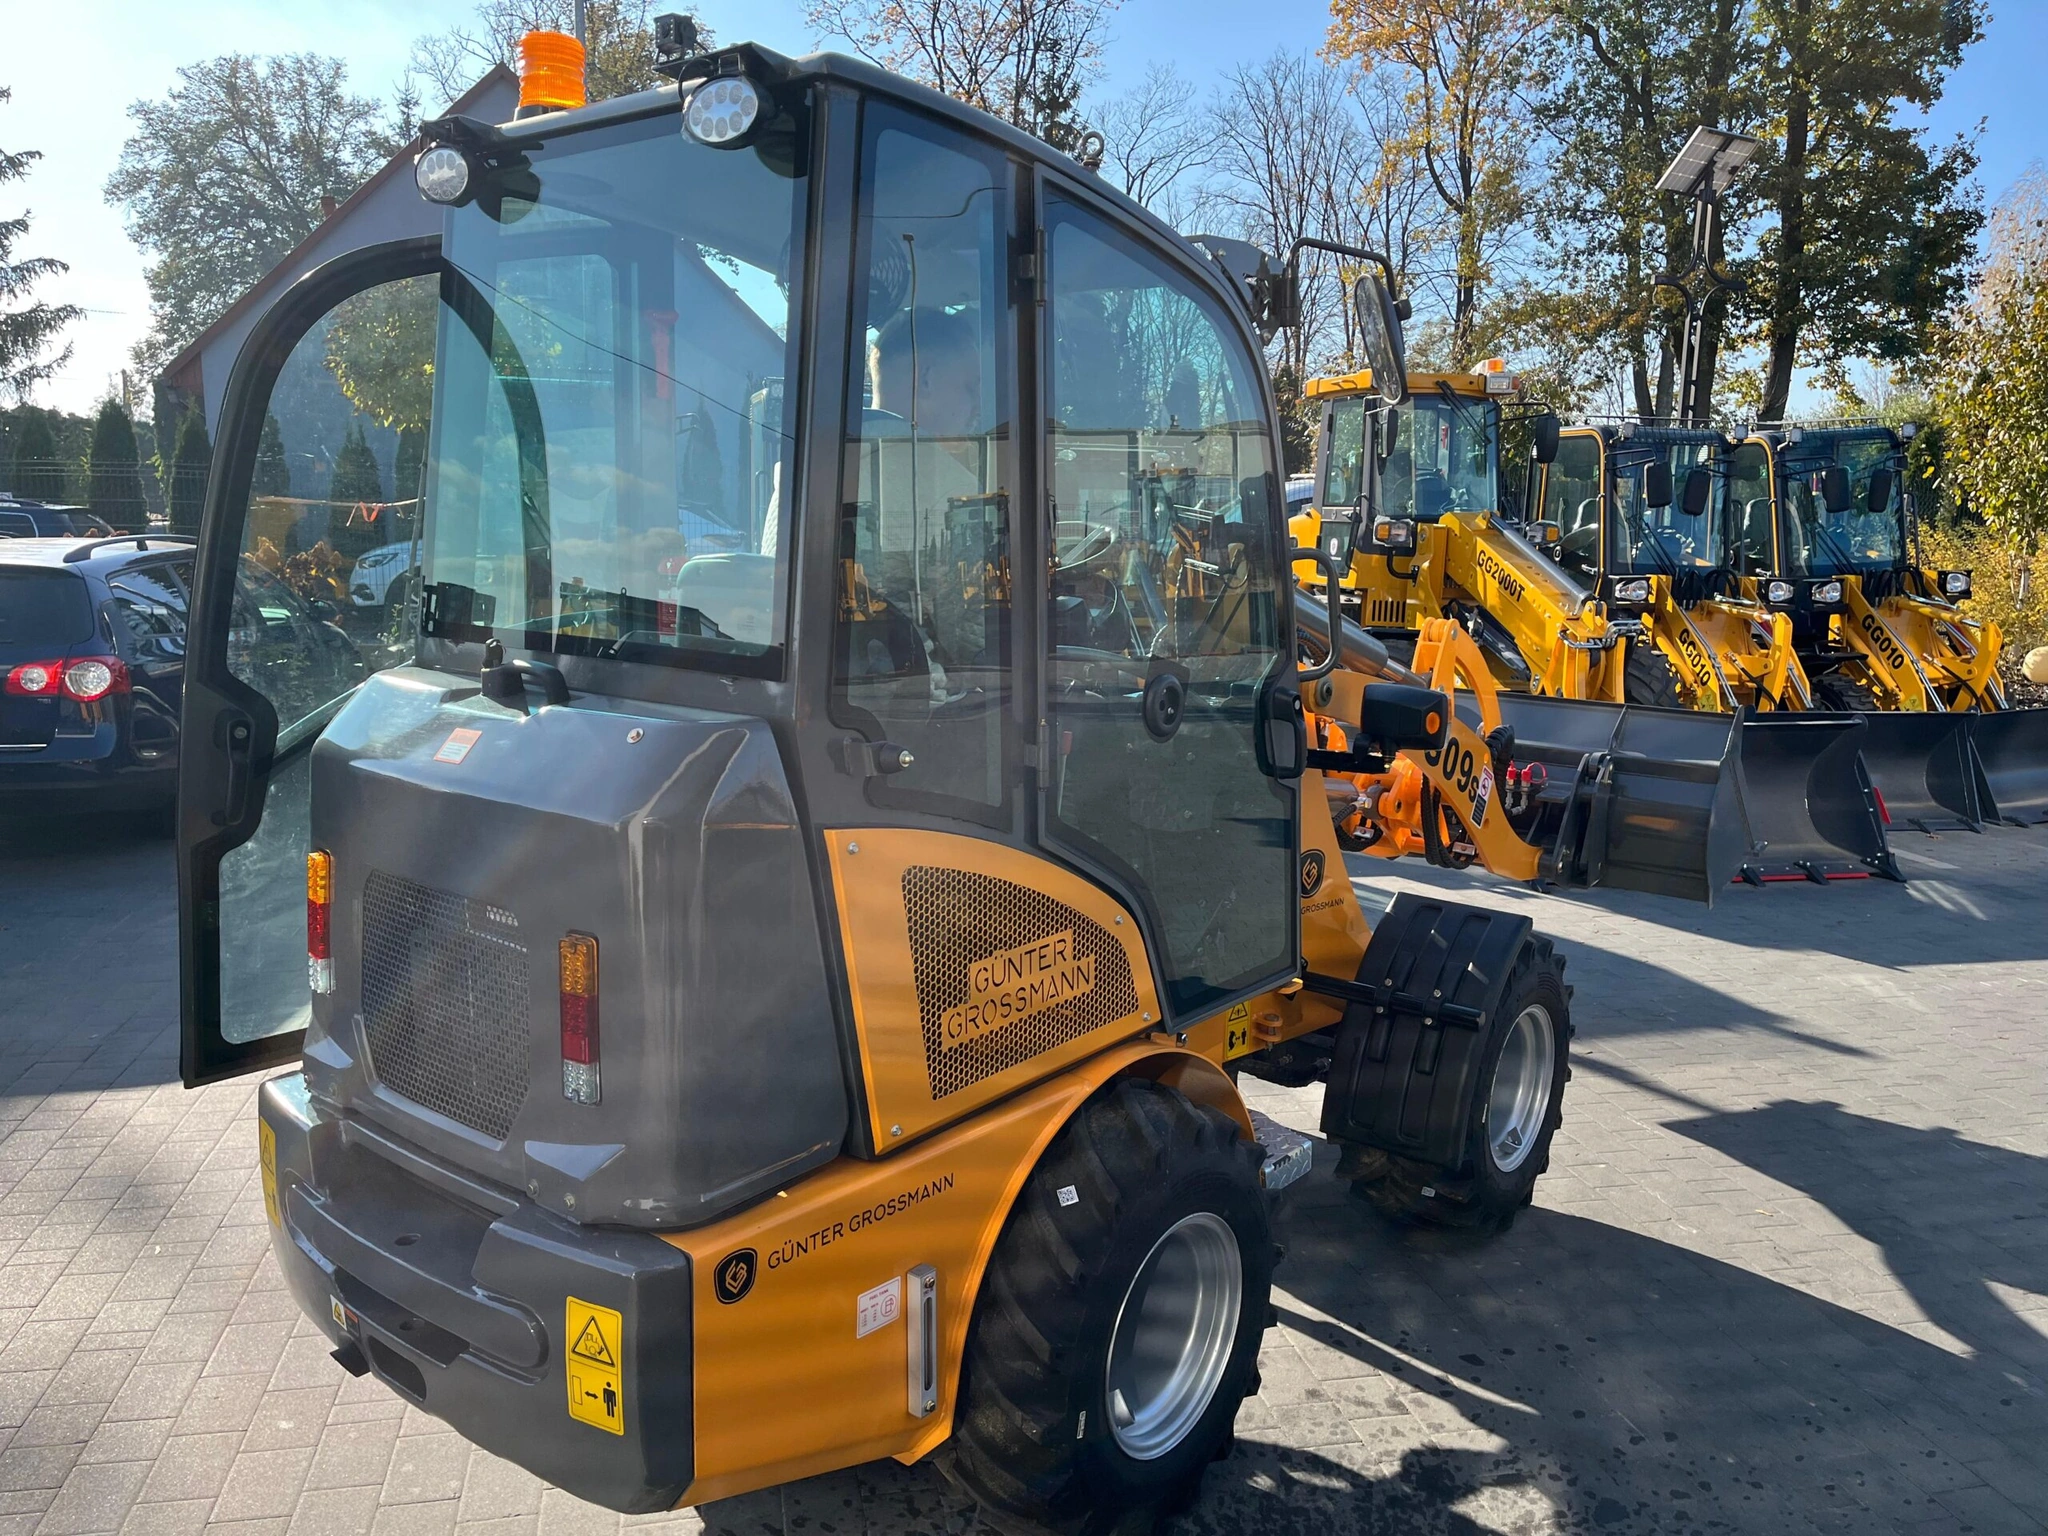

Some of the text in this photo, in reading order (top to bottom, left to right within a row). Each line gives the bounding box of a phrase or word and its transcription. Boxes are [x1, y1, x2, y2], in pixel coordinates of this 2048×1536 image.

[1477, 549, 1526, 602] GG2000T
[1679, 628, 1711, 686] GG010
[1862, 614, 1905, 669] GG010
[1301, 897, 1345, 915] GROSSMANN
[975, 938, 1067, 993] GÜNTER
[948, 961, 1090, 1039] GROSSMANN
[768, 1172, 954, 1270] GÜNTER GROSSMANN
